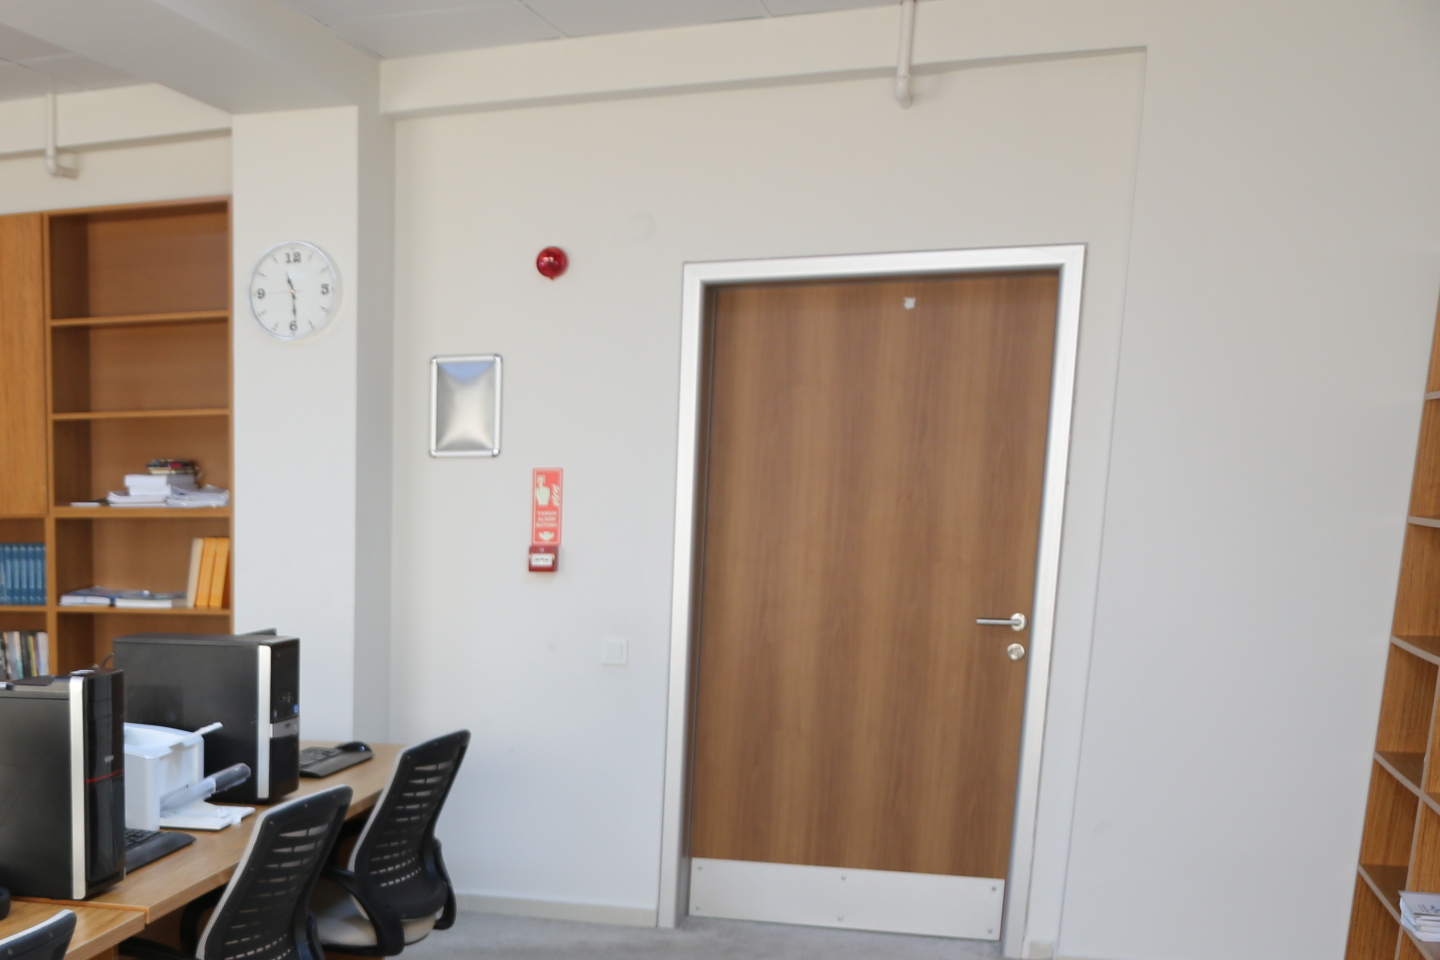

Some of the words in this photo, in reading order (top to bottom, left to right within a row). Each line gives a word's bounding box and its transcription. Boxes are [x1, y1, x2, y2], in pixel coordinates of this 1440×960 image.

[284, 251, 302, 263] 12
[257, 288, 266, 299] 9
[289, 320, 298, 331] 6
